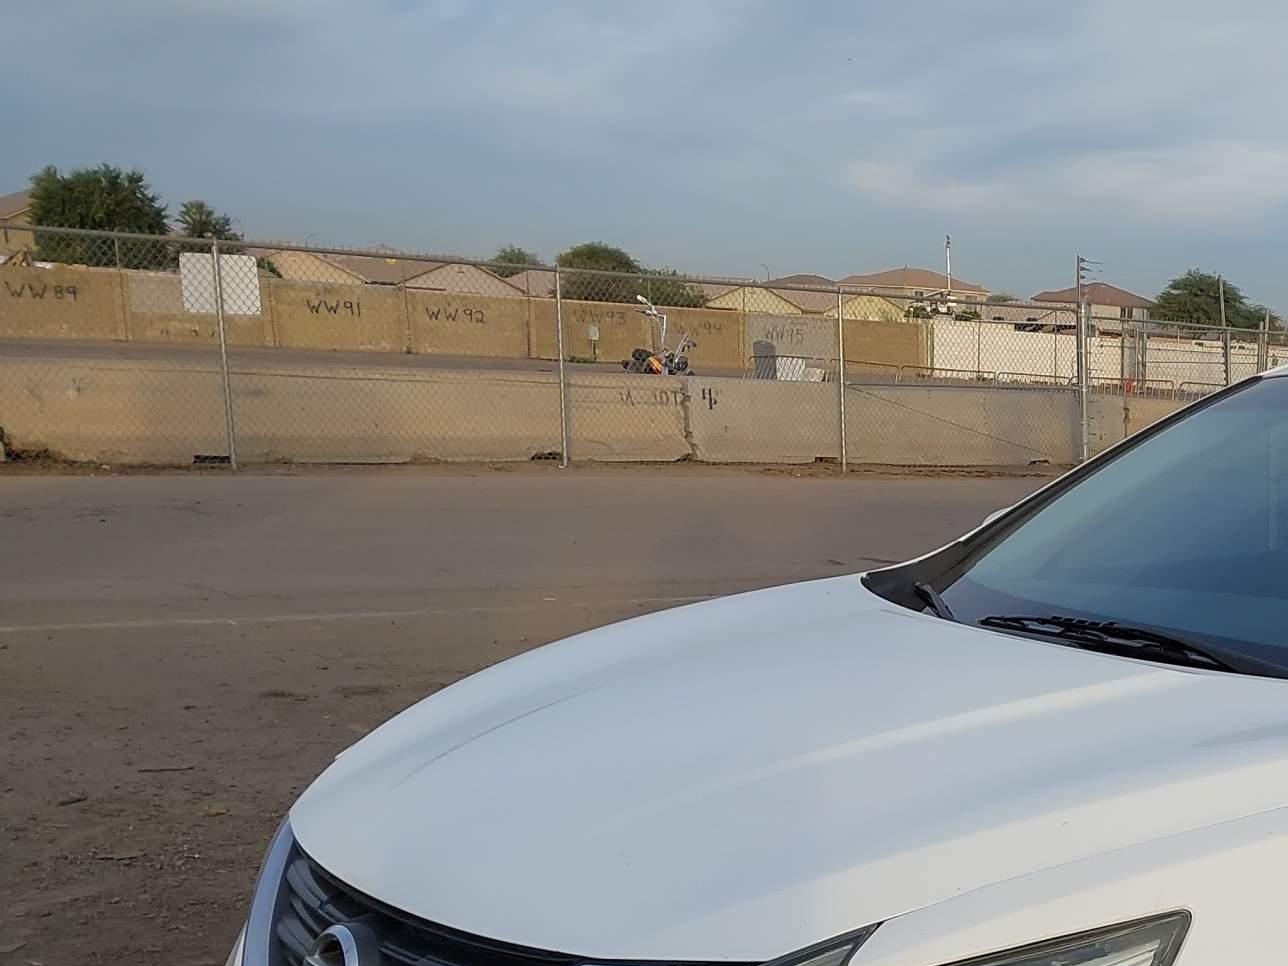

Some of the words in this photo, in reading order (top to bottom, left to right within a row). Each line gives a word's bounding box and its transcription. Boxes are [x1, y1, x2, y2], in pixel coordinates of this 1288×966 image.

[4, 281, 47, 299] WW
[54, 284, 78, 301] 89
[306, 299, 339, 314] WW
[344, 301, 361, 317] 91
[425, 307, 457, 322] WW
[463, 309, 486, 324] 92
